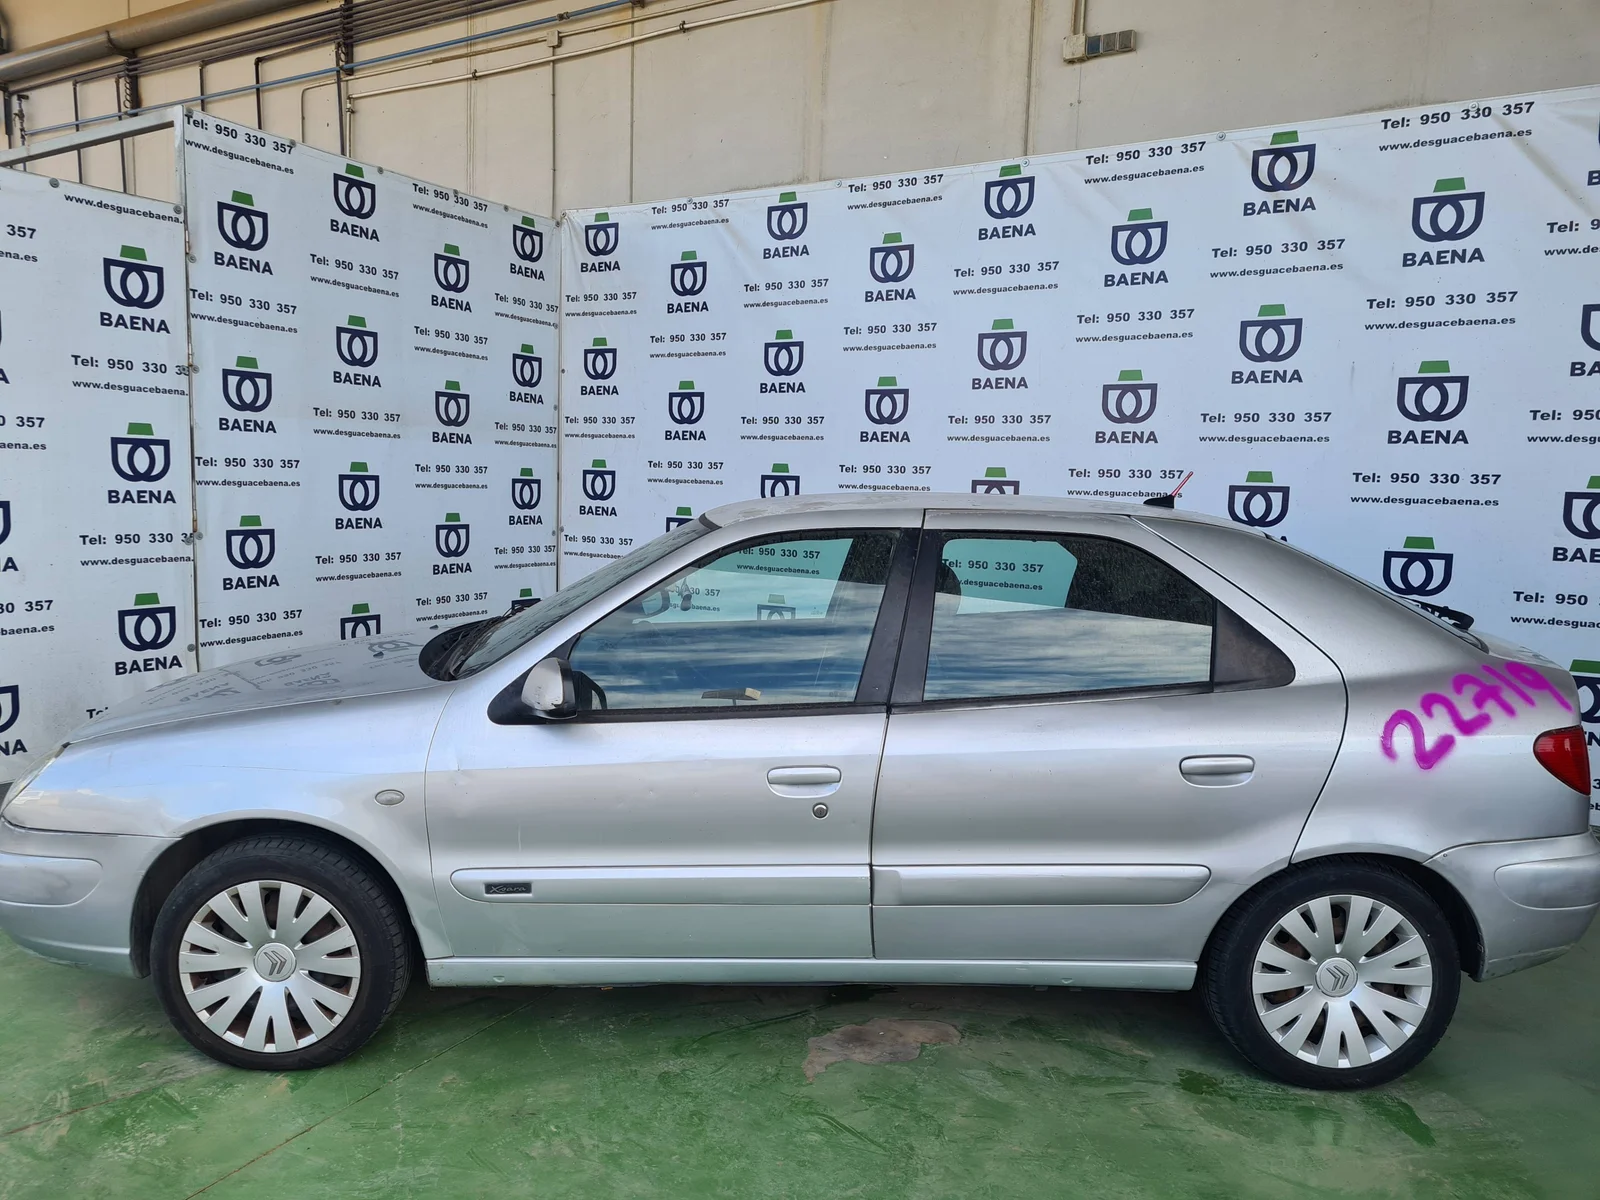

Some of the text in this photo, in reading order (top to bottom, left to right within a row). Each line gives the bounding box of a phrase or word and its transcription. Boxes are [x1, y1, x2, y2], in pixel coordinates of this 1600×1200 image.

[1380, 101, 1535, 130] Tel: 950 330 357
[185, 114, 293, 155] Tel: 950 330 357
[1379, 129, 1532, 152] www.desguacebaena.es
[184, 138, 294, 175] www.desguacebaena.es
[1085, 141, 1206, 165] Tel: 950 330 357
[1084, 165, 1205, 184] www.desguacebaena.es
[848, 173, 944, 193] Tel: 950 330 357
[847, 195, 943, 210] www.desguacebaena.es
[1243, 196, 1316, 217] BAENA
[412, 203, 488, 229] www.desguacebaena.es
[330, 218, 380, 242] BAENA
[651, 218, 729, 230] www.desguacebaena.es
[6, 224, 37, 239] 357
[978, 223, 1036, 241] BAENA
[763, 244, 810, 260] BAENA
[1211, 238, 1346, 258] Tel: 950 330 357
[214, 251, 274, 276] BAENA
[1402, 247, 1485, 268] BAENA
[309, 253, 399, 280] Tel: 950 330 357
[510, 262, 545, 282] BAENA
[580, 260, 621, 273] BAENA
[954, 261, 1060, 278] Tel: 950 330 357
[1210, 263, 1344, 278] www.desguacebaena.es
[743, 278, 829, 292] Tel: 950 330 357
[1104, 270, 1169, 287] BAENA
[310, 275, 400, 297] www.desguacebaena.es
[953, 283, 1058, 295] www.desguacebaena.es
[189, 289, 297, 315] Tel: 950 330 357
[565, 291, 637, 303] Tel: 950 330 357
[865, 288, 916, 303] BAENA
[1366, 291, 1518, 309] Tel: 950 330 357
[431, 294, 472, 313] BAENA
[667, 301, 709, 314] BAENA
[743, 298, 828, 308] www.desguacebaena.es
[565, 310, 637, 318] www.desguacebaena.es
[99, 311, 171, 334] BAENA
[191, 311, 298, 334] www.desguacebaena.es
[1364, 317, 1516, 330] www.desguacebaena.es
[414, 325, 488, 345] Tel: 950 330 357
[650, 332, 727, 343] Tel: 950 330 357
[1075, 332, 1193, 343] www.desguacebaena.es
[414, 346, 488, 361] www.desguacebaena.es
[843, 343, 937, 352] www.desguacebaena.es
[649, 351, 726, 359] www.desguacebaena.es
[71, 354, 167, 374] Tel: 950 330
[333, 370, 382, 388] BAENA
[972, 376, 1028, 390] BAENA
[1231, 369, 1303, 384] BAENA
[580, 385, 619, 396] BAENA
[760, 381, 806, 394] BAENA
[509, 391, 544, 405] BAENA
[564, 416, 635, 424] Tel: 950 330 357
[948, 414, 1051, 424] Tel: 950 330 357
[1200, 412, 1332, 423] Tel: 950 330 357
[219, 417, 277, 434] BAENA
[313, 428, 401, 439] www.desguacebaena.es
[432, 431, 472, 445] BAENA
[564, 432, 635, 440] www.desguacebaena.es
[665, 430, 707, 441] BAENA
[740, 434, 824, 442] www.desguacebaena.es
[860, 431, 911, 443] BAENA
[947, 434, 1050, 443] www.desguacebaena.es
[1095, 430, 1159, 444] BAENA
[1199, 434, 1330, 444] www.desguacebaena.es
[1387, 429, 1469, 445] BAENA
[495, 439, 557, 449] www.desguacebaena.es
[195, 478, 300, 488] www.desguacebaena.es
[647, 477, 724, 485] www.desguacebaena.es
[1352, 472, 1502, 485] Tel: 950 330 357
[415, 482, 488, 490] www.desguacebaena.es
[838, 483, 931, 492] www.desguacebaena.es
[107, 489, 177, 504] BAENA
[1350, 495, 1499, 506] www.desguacebaena.es
[579, 505, 618, 517] BAENA
[335, 517, 383, 530] BAENA
[509, 515, 543, 526] BAENA
[315, 552, 402, 565] Tel: 950 330 357
[758, 547, 820, 559] 950 330 357
[432, 562, 472, 575] BAENA
[494, 561, 556, 570] www.desguacebaena.es
[737, 563, 820, 575] www.desguacebaena.es
[222, 574, 280, 591] BAENA
[315, 571, 402, 582] www.desguacebaena.es
[199, 609, 303, 628] Tel: 950 330 357
[416, 609, 488, 622] www.desguacebaena.es
[199, 630, 303, 648] www.desguacebaena.es
[114, 655, 183, 676] BAENA
